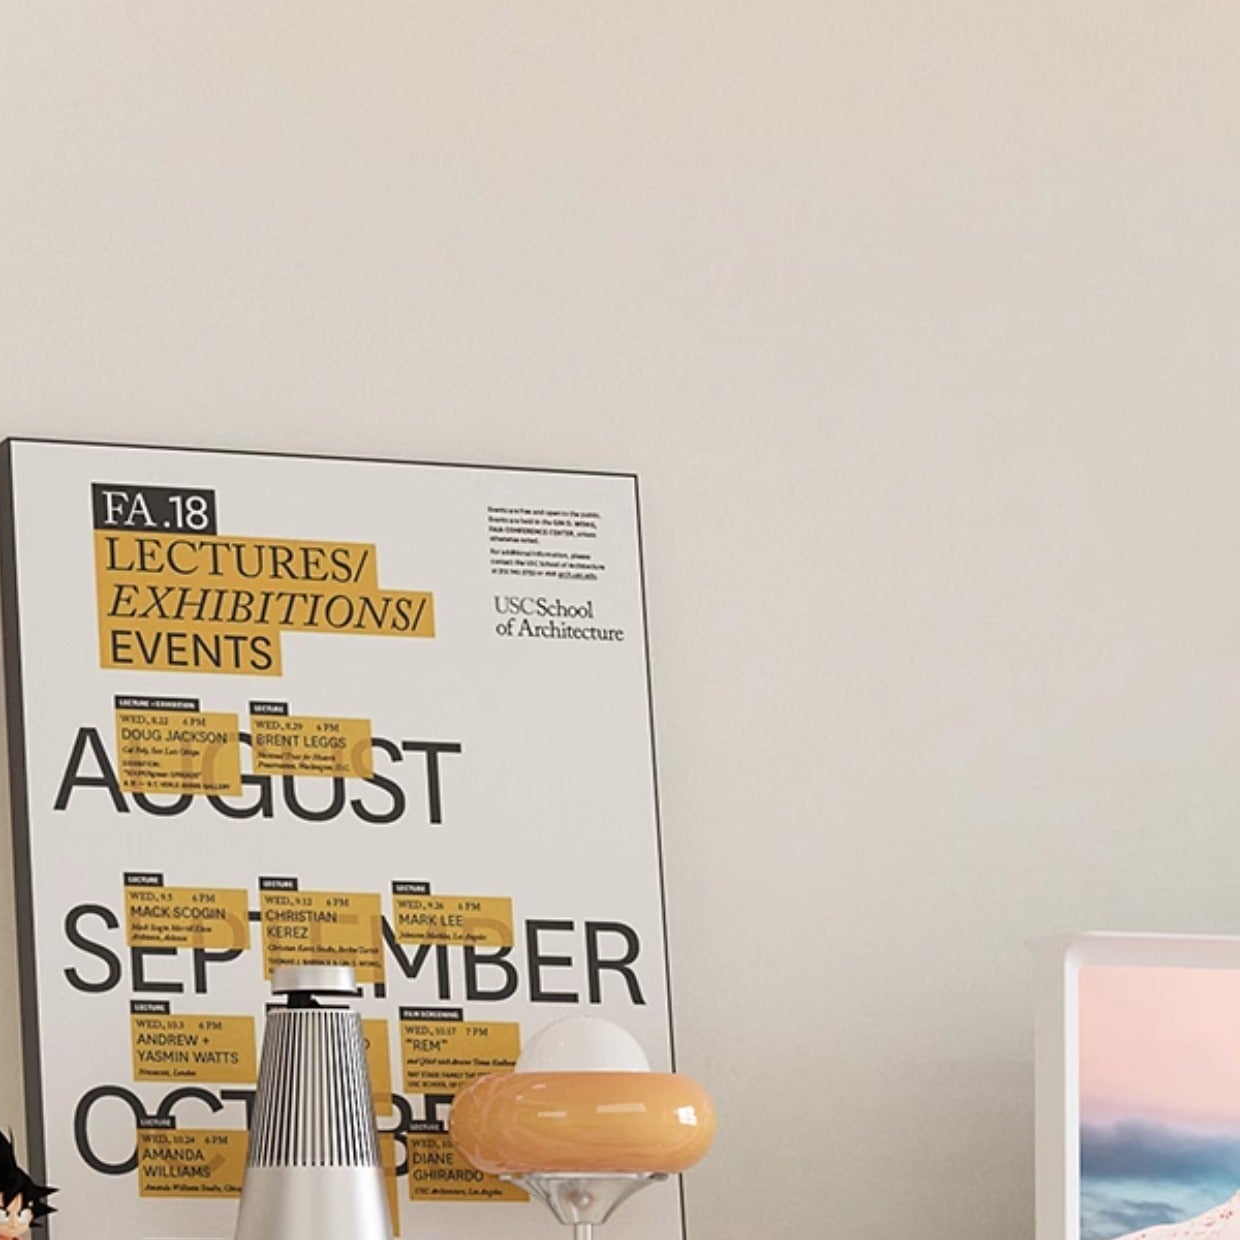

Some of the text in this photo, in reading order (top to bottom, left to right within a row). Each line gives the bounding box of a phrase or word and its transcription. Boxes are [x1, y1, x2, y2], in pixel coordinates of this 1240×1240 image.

[105, 537, 368, 583] LECTURES/
[107, 584, 426, 632] EXHIBITIONS/
[494, 596, 594, 619] USC School
[496, 617, 624, 642] of Architecture
[112, 630, 273, 670] EVENTS
[324, 723, 339, 732] PM
[121, 727, 228, 743] DOUG JACKSON
[256, 733, 347, 749] BRENT LEGGS
[53, 727, 462, 825] AUGUST
[131, 905, 226, 919] MACK SCOGIN
[465, 902, 481, 911] PM
[265, 910, 337, 923] CHRISTIAN
[399, 914, 464, 927] MARK LEE
[266, 926, 309, 939] KEREZ
[63, 903, 647, 1005] SEPTEMBER
[473, 1028, 488, 1036] PM
[136, 1033, 198, 1046] ANDREW
[137, 1050, 239, 1064] YASMIN WATTS
[143, 1148, 205, 1161] AMANDA
[413, 1153, 453, 1165] DIANE
[143, 1165, 211, 1178] WILLIAMS
[414, 1169, 484, 1182] GHIRARDO
